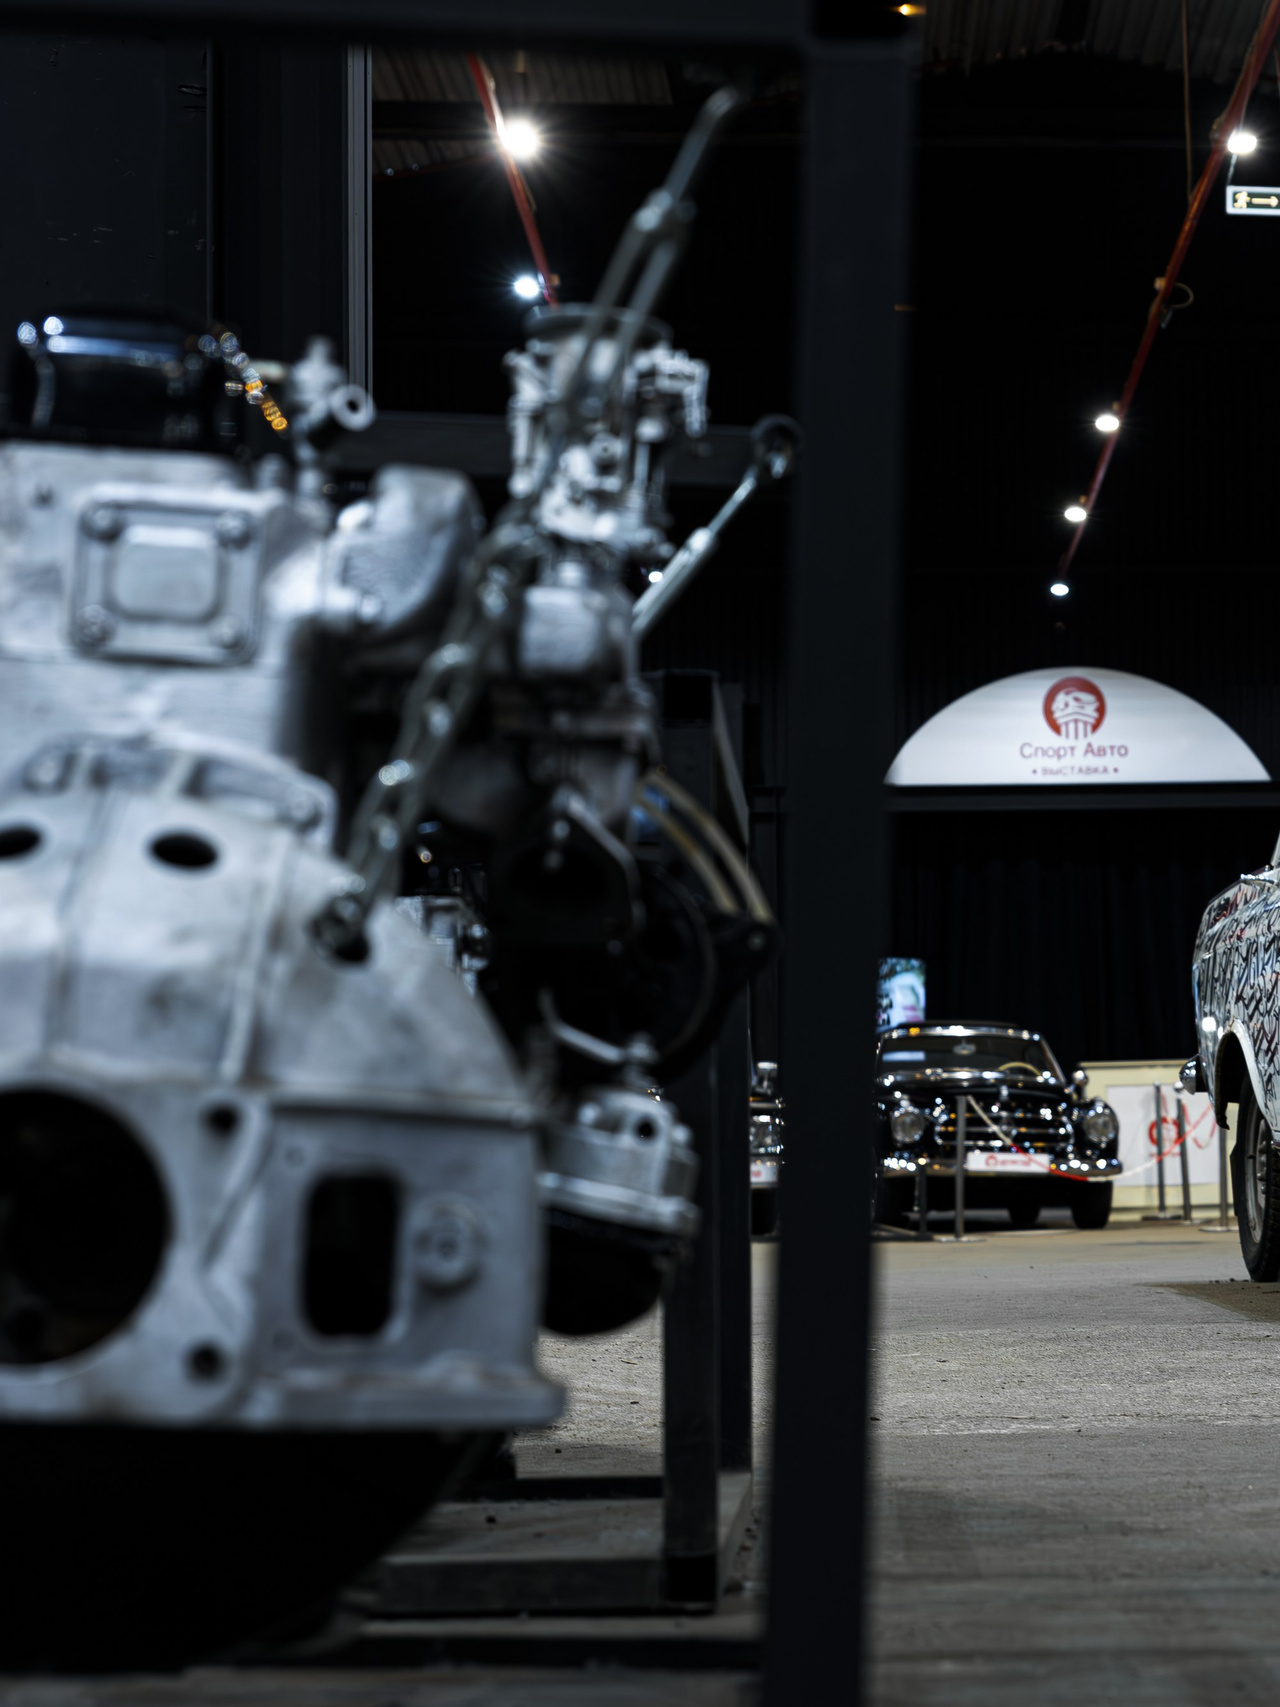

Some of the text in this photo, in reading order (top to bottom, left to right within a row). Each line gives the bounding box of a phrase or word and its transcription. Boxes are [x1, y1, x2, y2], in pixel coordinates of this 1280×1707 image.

[1019, 742, 1129, 760] Спорт Авто
[1042, 766, 1109, 775] ВЫСТАВКА
